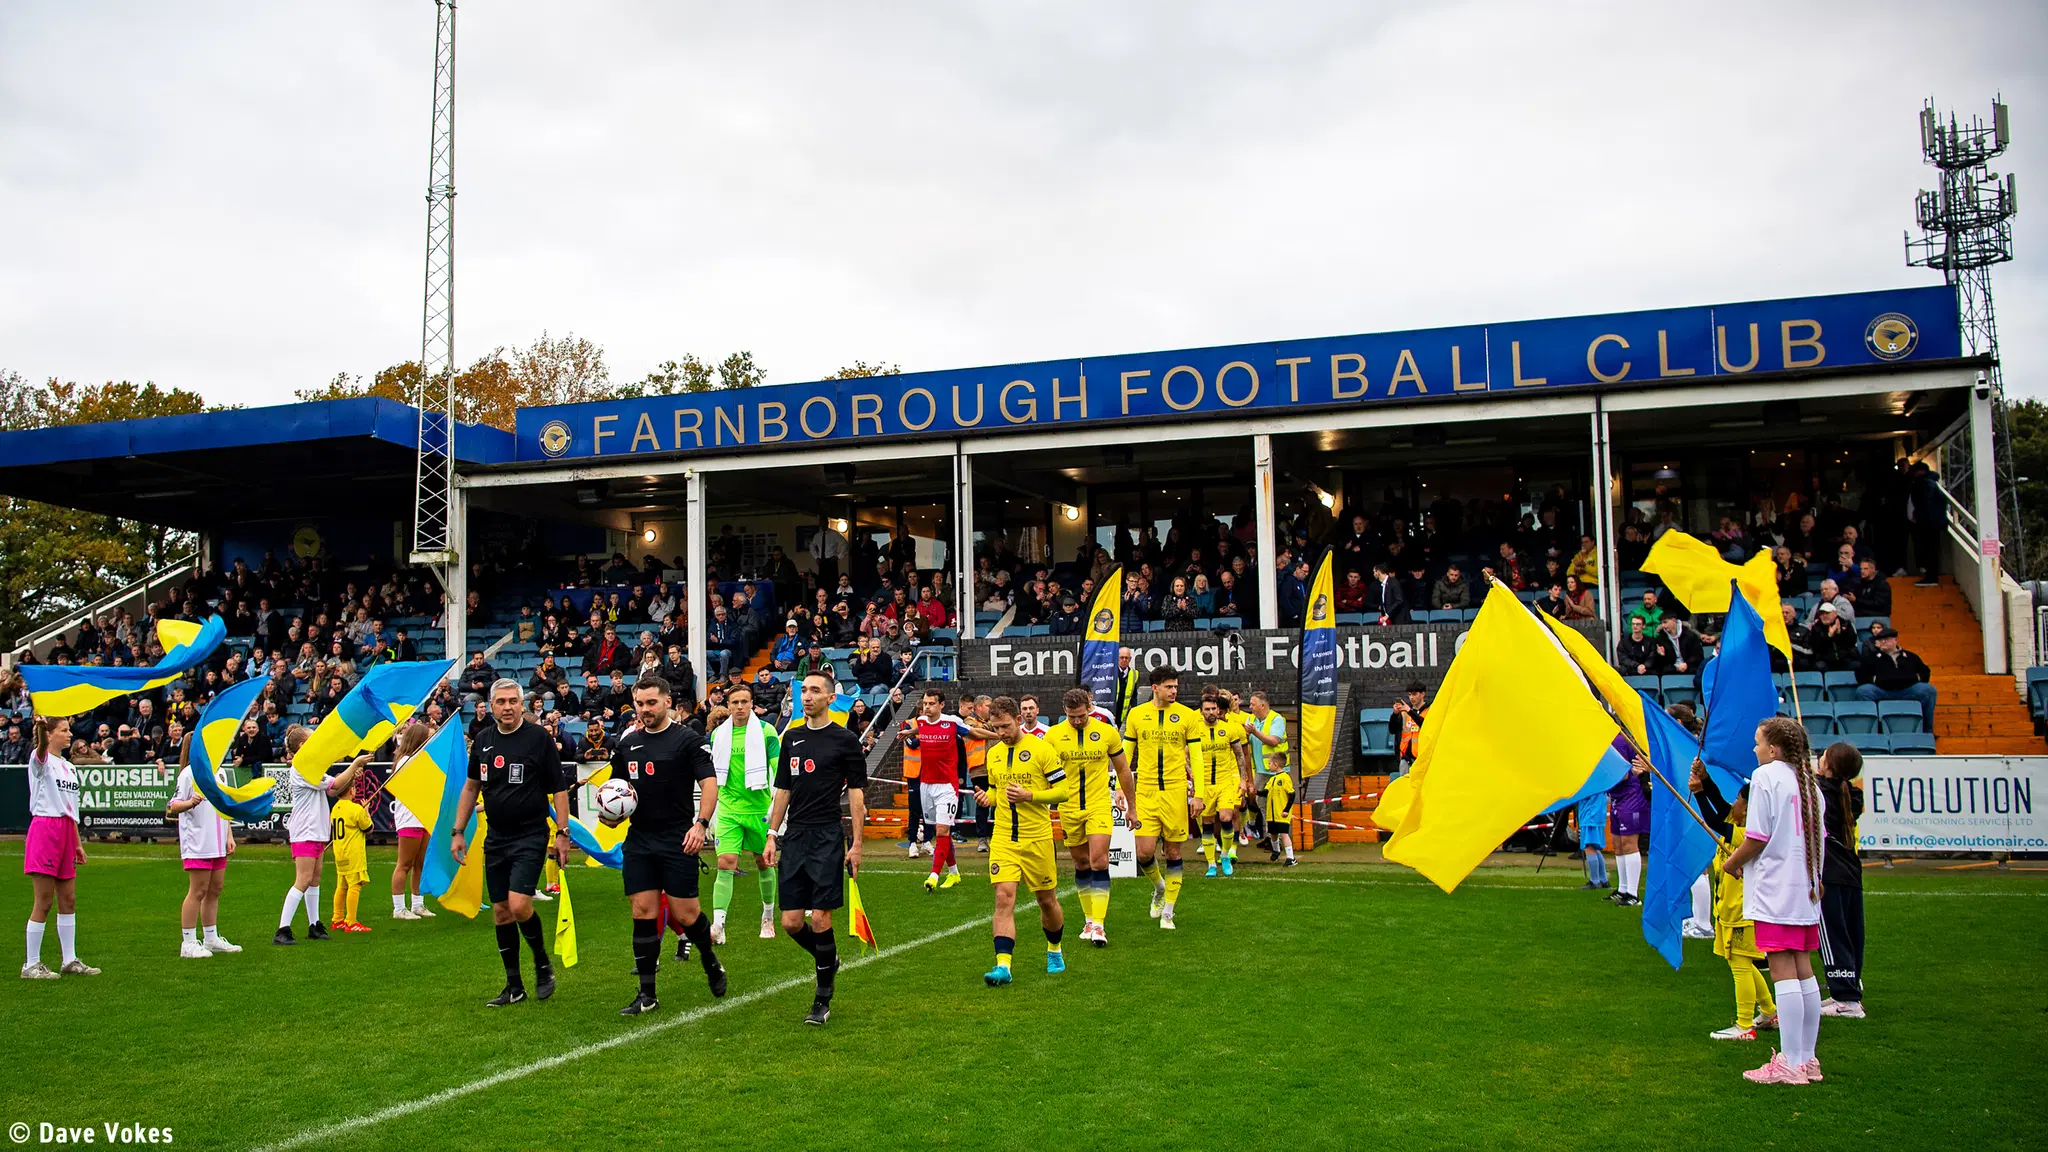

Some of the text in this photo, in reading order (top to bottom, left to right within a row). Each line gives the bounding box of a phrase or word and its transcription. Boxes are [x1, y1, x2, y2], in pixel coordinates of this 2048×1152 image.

[593, 319, 1826, 454] FARNBOROUGH FOOTBALL CLUB
[990, 640, 1246, 676] Farnrough
[77, 769, 175, 787] YOURSELF
[79, 791, 111, 808] AL!
[114, 791, 168, 799] EDEN VAUXHALL
[1872, 777, 2032, 814] EVOLUTION
[947, 803, 956, 814] 10
[93, 817, 164, 825] EDENMOTORGROUP.COM
[1892, 817, 1965, 825] CONDITIONING
[1968, 818, 2012, 826] SERVICES
[2015, 818, 2033, 826] LTD
[332, 817, 345, 840] 10
[1859, 836, 1876, 846] 40
[1827, 969, 1856, 978] adidas
